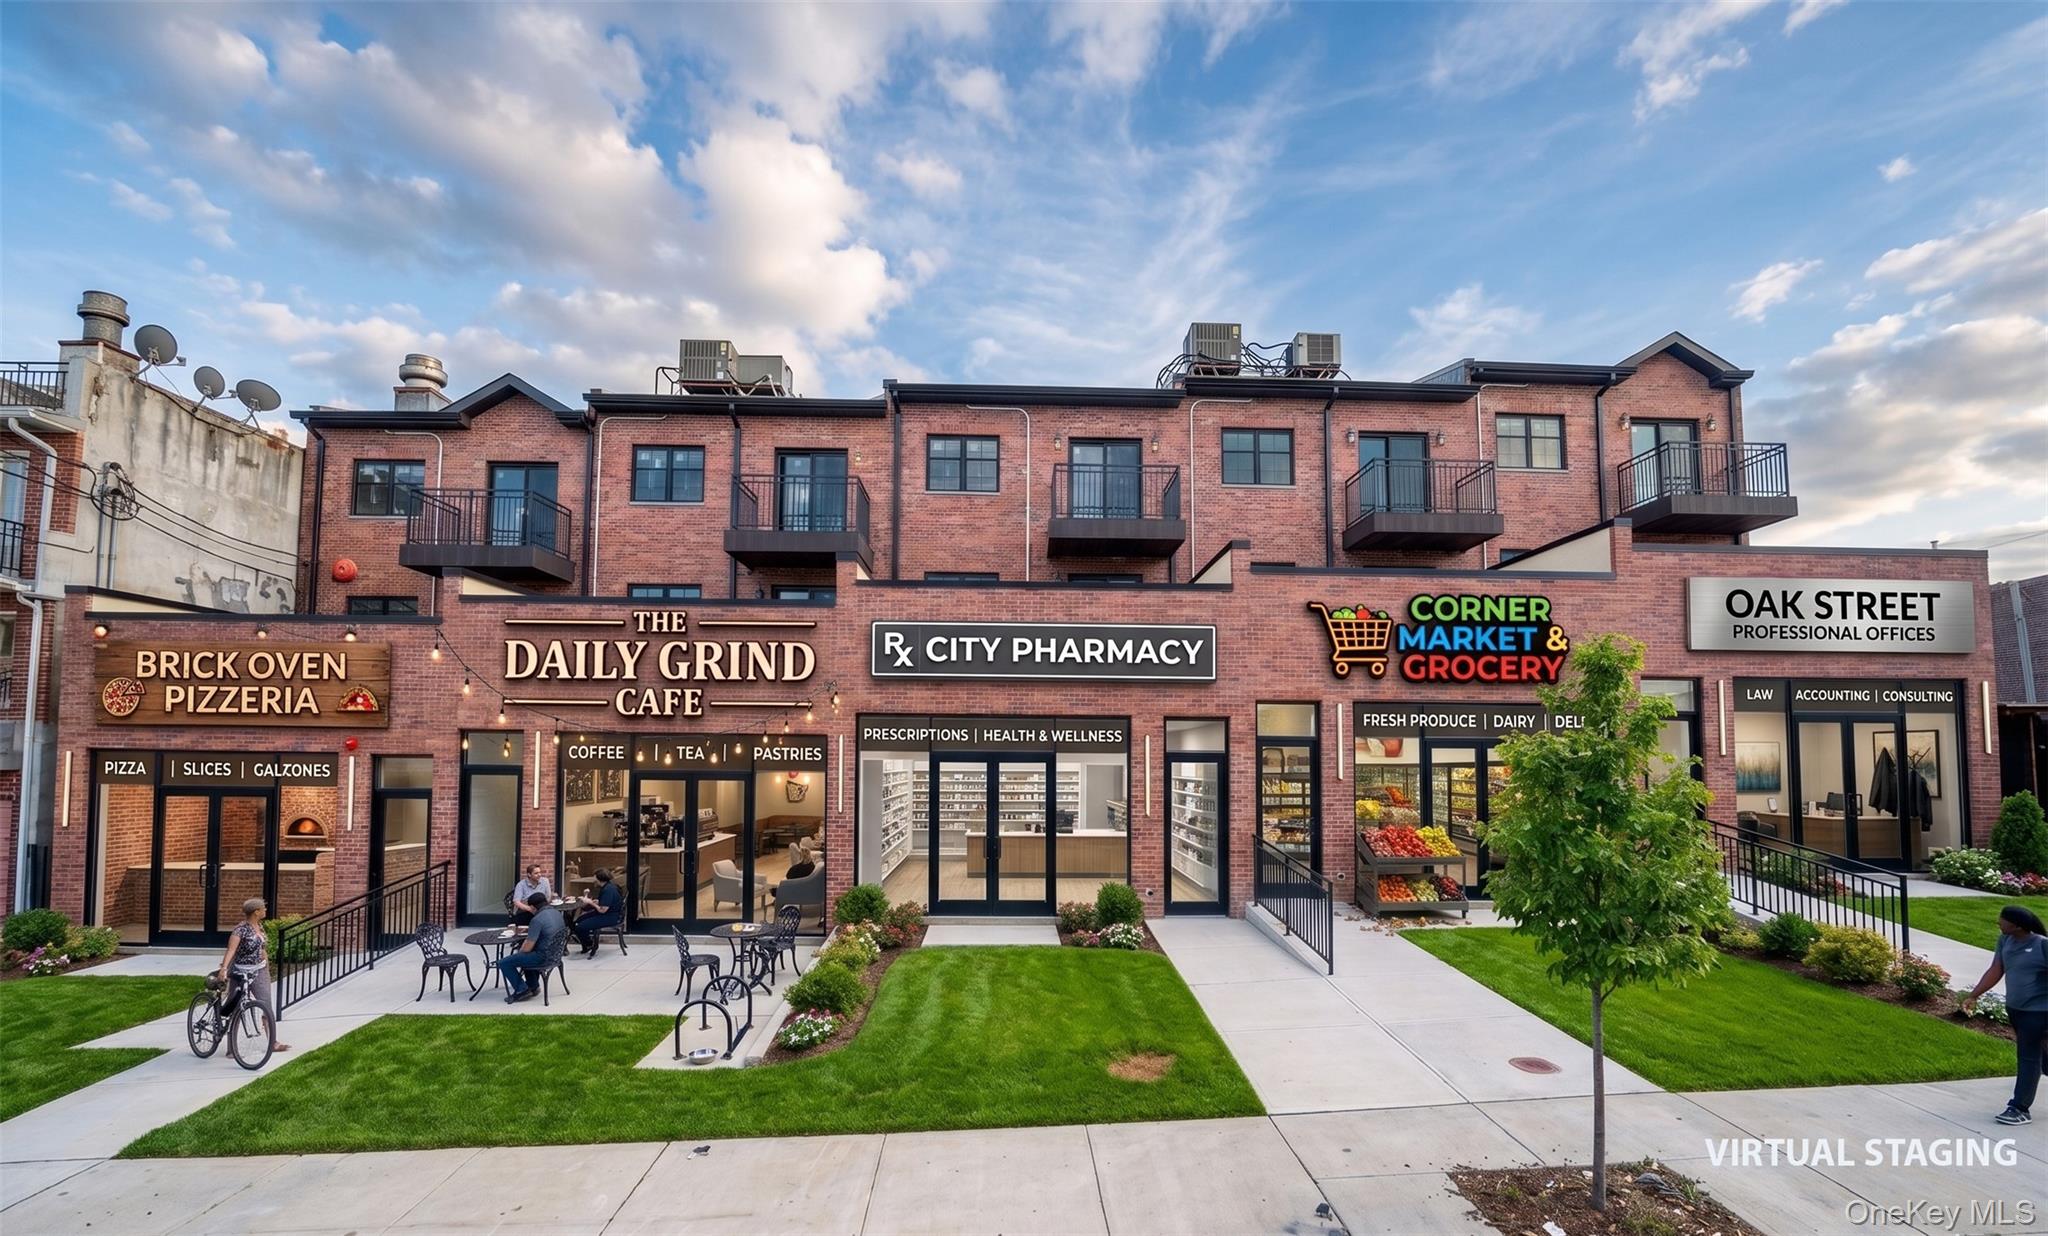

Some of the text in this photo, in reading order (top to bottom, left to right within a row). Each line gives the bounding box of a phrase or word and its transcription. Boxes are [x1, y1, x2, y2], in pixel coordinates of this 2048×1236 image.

[1410, 596, 1551, 622] CORNER
[1725, 588, 1942, 623] OAK STREET
[632, 610, 687, 633] THE
[1732, 624, 1937, 642] PROFESSIONAL OFFICES
[925, 636, 1003, 663] CITY
[1011, 637, 1205, 665] PHARMACY
[1398, 625, 1569, 651] MARKET &
[135, 650, 347, 681] BRICK OVEN
[503, 640, 816, 681] DAILY GRIND
[1402, 654, 1564, 681] GROCERY
[164, 684, 320, 715] PIZZERIA
[614, 687, 704, 717] CAFE
[1746, 688, 1954, 704] LAW ACCOUNTING CONSULTING
[1363, 713, 1407, 728] FRESH
[1410, 713, 1477, 729] PRODUCE
[1493, 714, 1536, 729] DAIRY
[863, 727, 1123, 743] PRESCRIPTIONS HEALTH & WELLNESS
[568, 745, 822, 762] COFFEE TEA PASTRIES
[104, 760, 147, 776] PIZZA
[183, 761, 232, 777] SLICES
